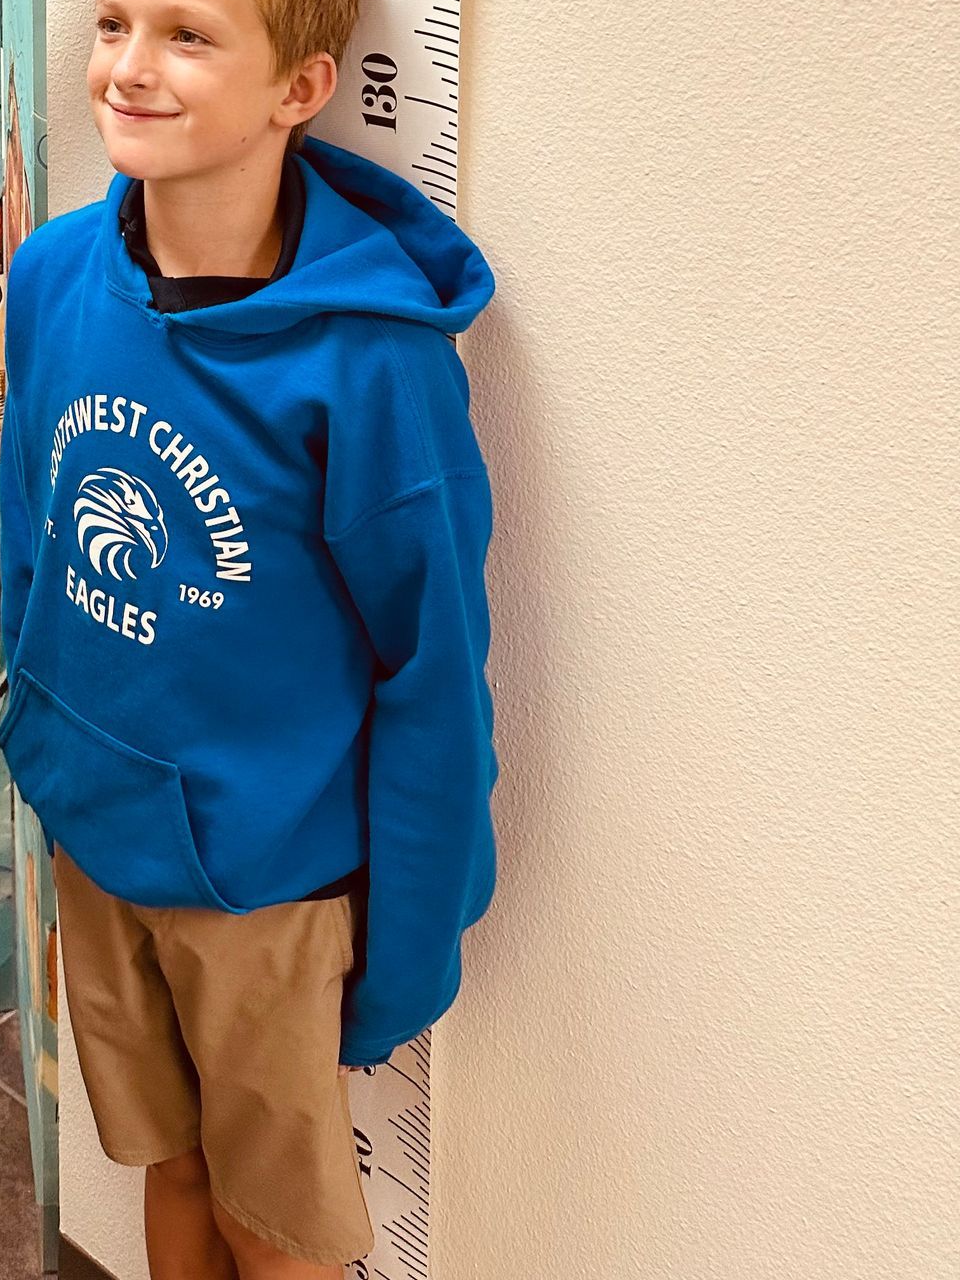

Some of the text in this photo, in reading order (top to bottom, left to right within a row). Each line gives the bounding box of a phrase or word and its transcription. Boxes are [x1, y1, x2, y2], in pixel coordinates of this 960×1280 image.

[361, 52, 398, 134] 130
[148, 420, 252, 582] CHRISTIAN
[65, 565, 157, 645] EAGLES
[179, 584, 225, 610] 1969
